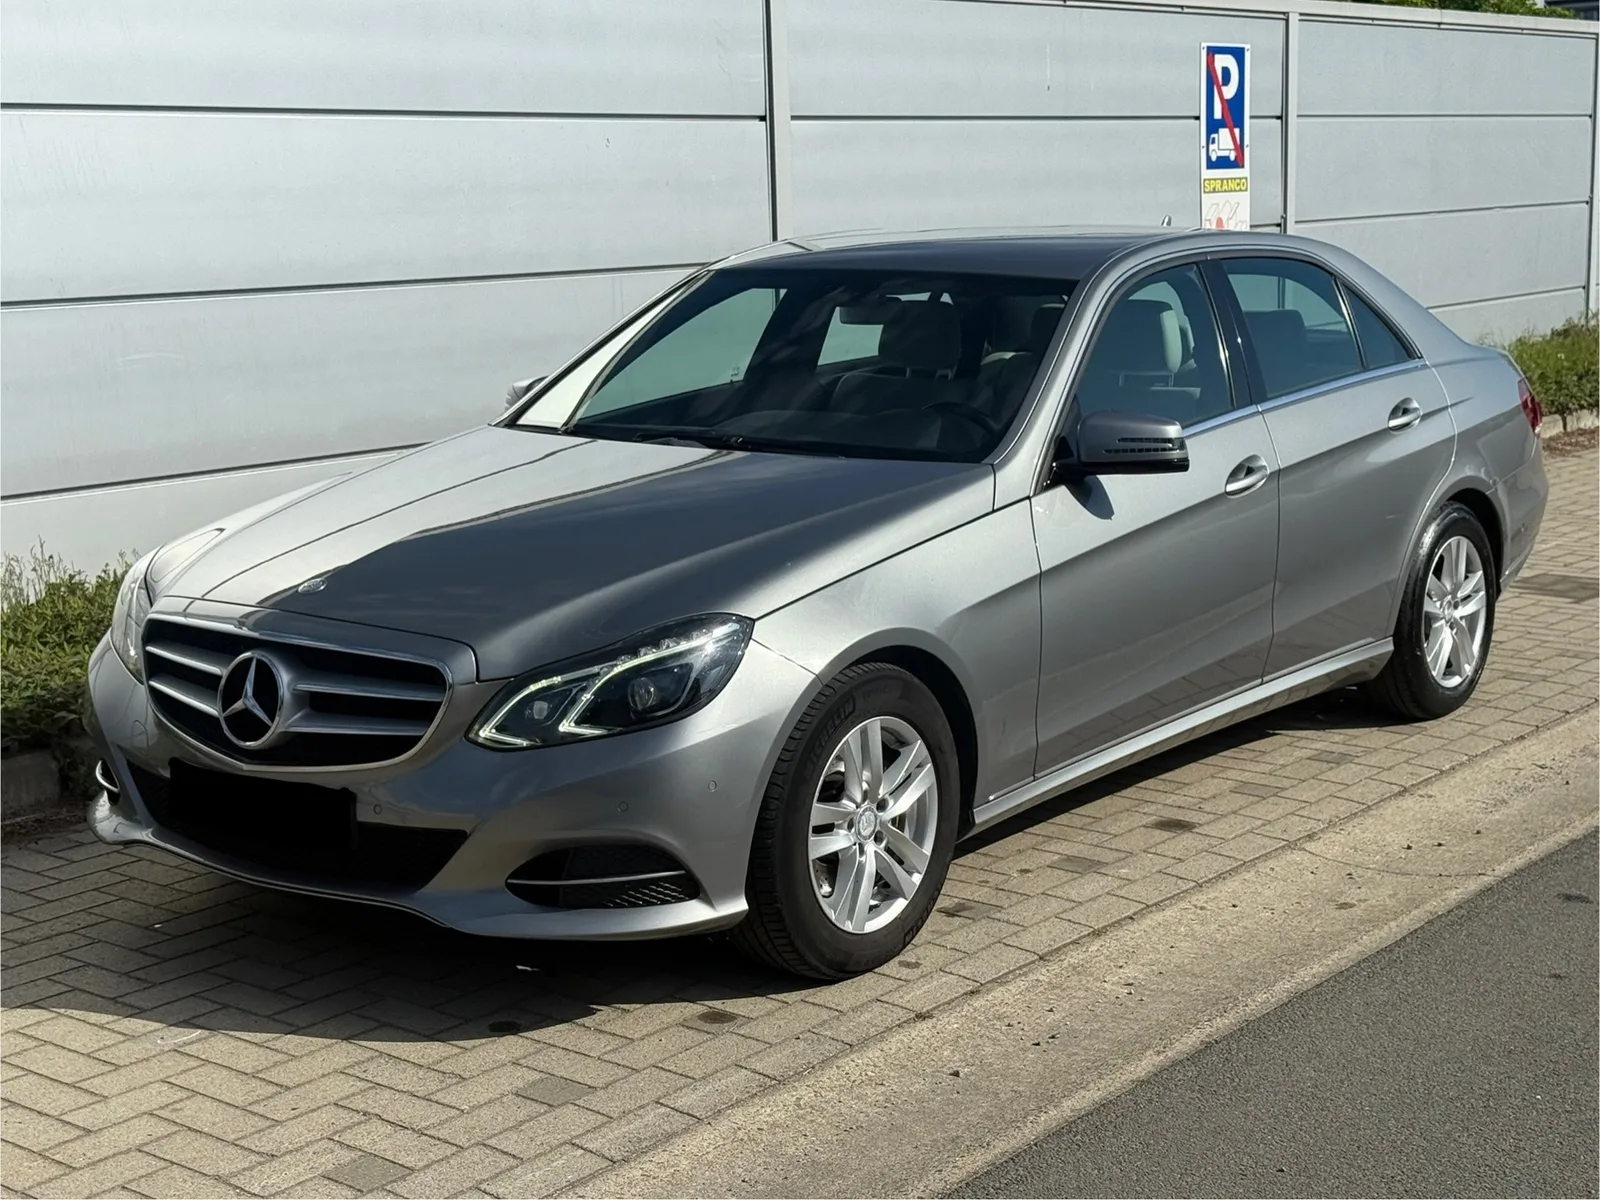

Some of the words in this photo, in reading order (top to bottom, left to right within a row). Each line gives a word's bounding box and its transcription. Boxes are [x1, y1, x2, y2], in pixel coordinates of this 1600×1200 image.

[1213, 54, 1239, 119] P
[1204, 178, 1247, 192] SPRANCO
[803, 695, 855, 781] MICHELIN
